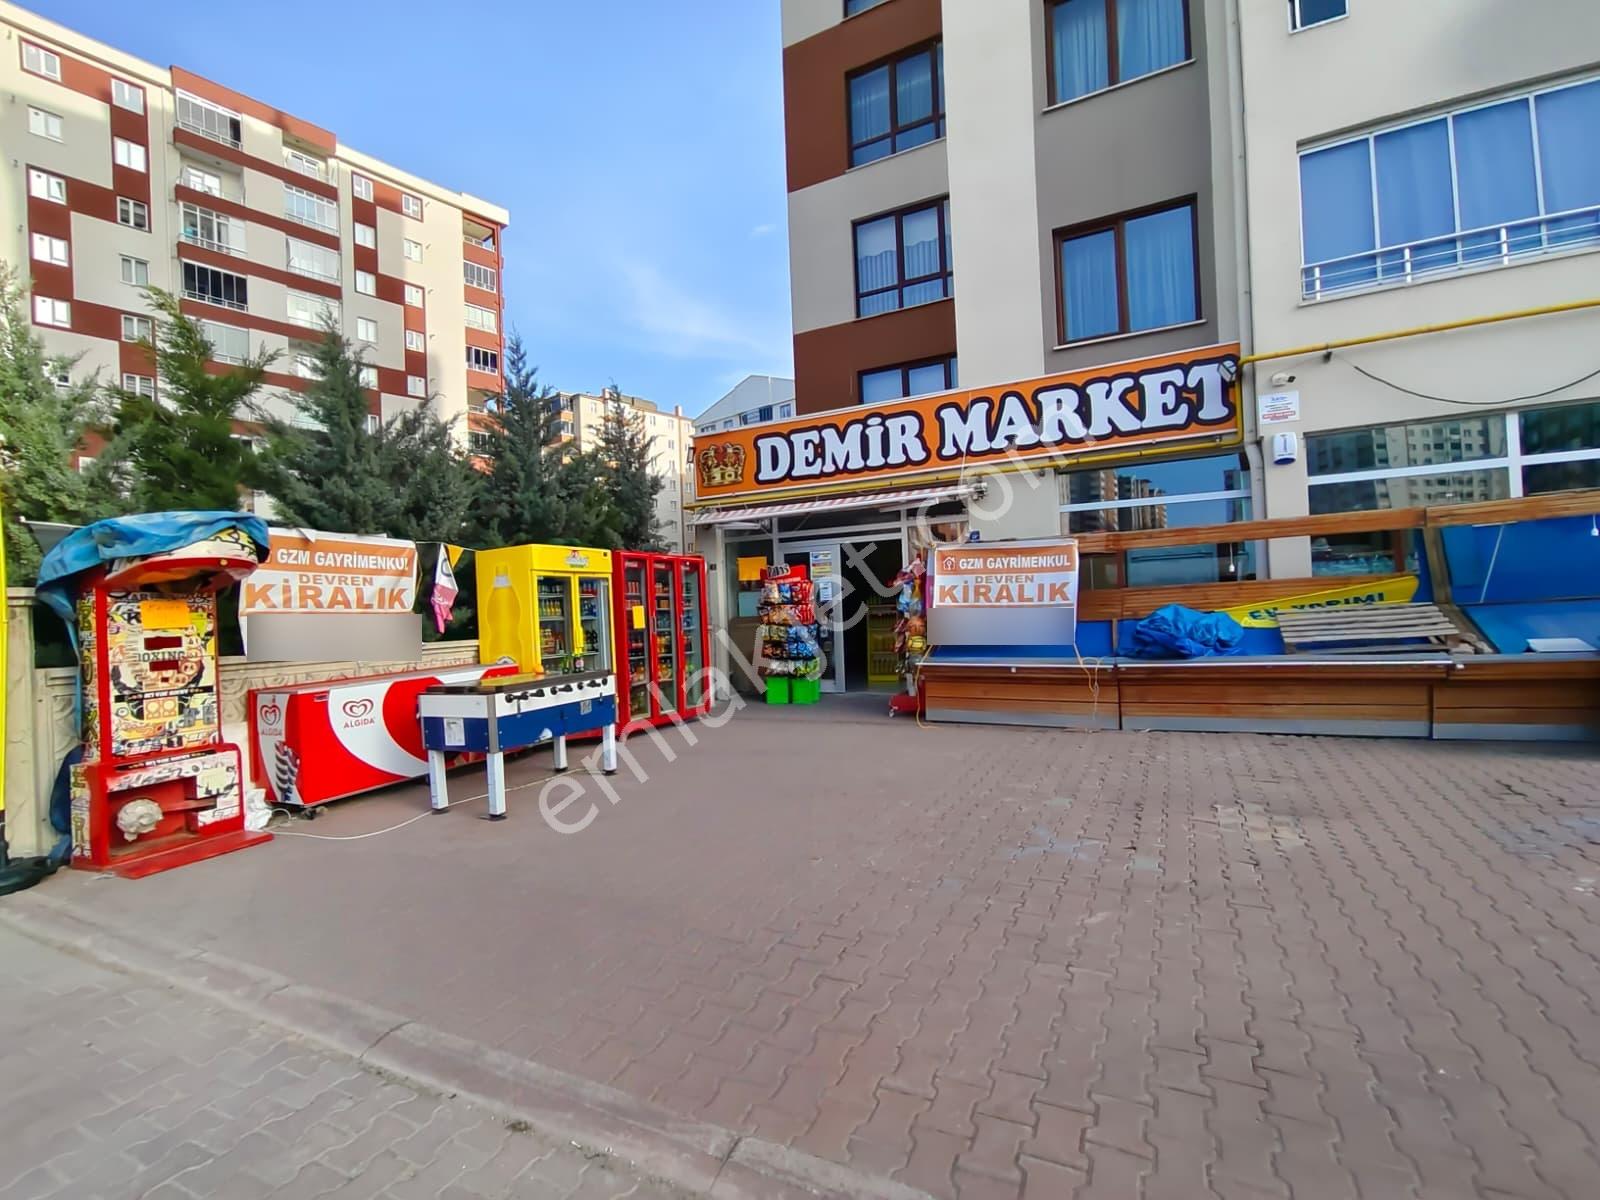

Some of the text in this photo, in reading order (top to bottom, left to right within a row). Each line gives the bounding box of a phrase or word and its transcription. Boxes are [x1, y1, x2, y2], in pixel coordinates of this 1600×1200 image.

[939, 361, 1232, 457] MARKET
[277, 549, 310, 565] GZM
[959, 554, 1071, 570] GZM GAYRİMENKUL
[298, 574, 374, 586] DEVREN
[974, 574, 1035, 584] DEVREN
[245, 578, 409, 610] KİRALIK
[938, 580, 1071, 604] KİRALIK
